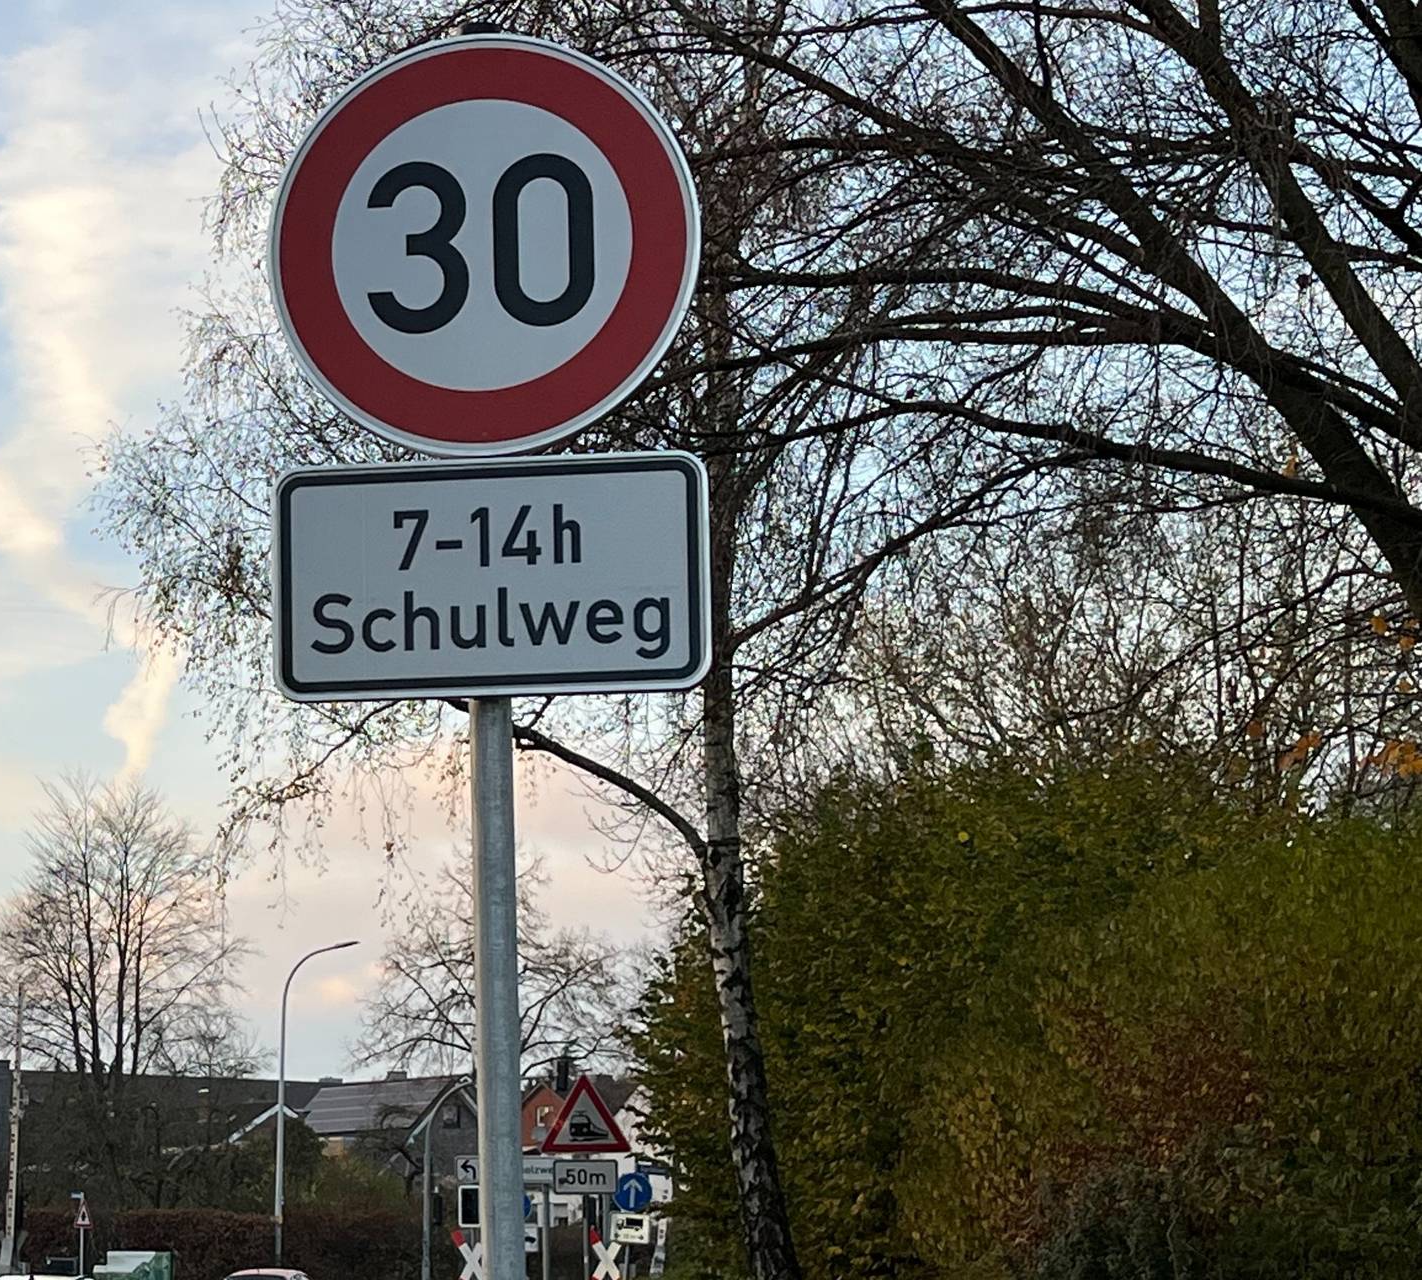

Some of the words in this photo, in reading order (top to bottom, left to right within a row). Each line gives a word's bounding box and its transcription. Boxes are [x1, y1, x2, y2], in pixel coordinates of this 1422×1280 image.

[367, 153, 595, 334] 30
[394, 504, 582, 571] 7-14h
[310, 587, 671, 660] Schulweg
[565, 1168, 607, 1185] 50m
